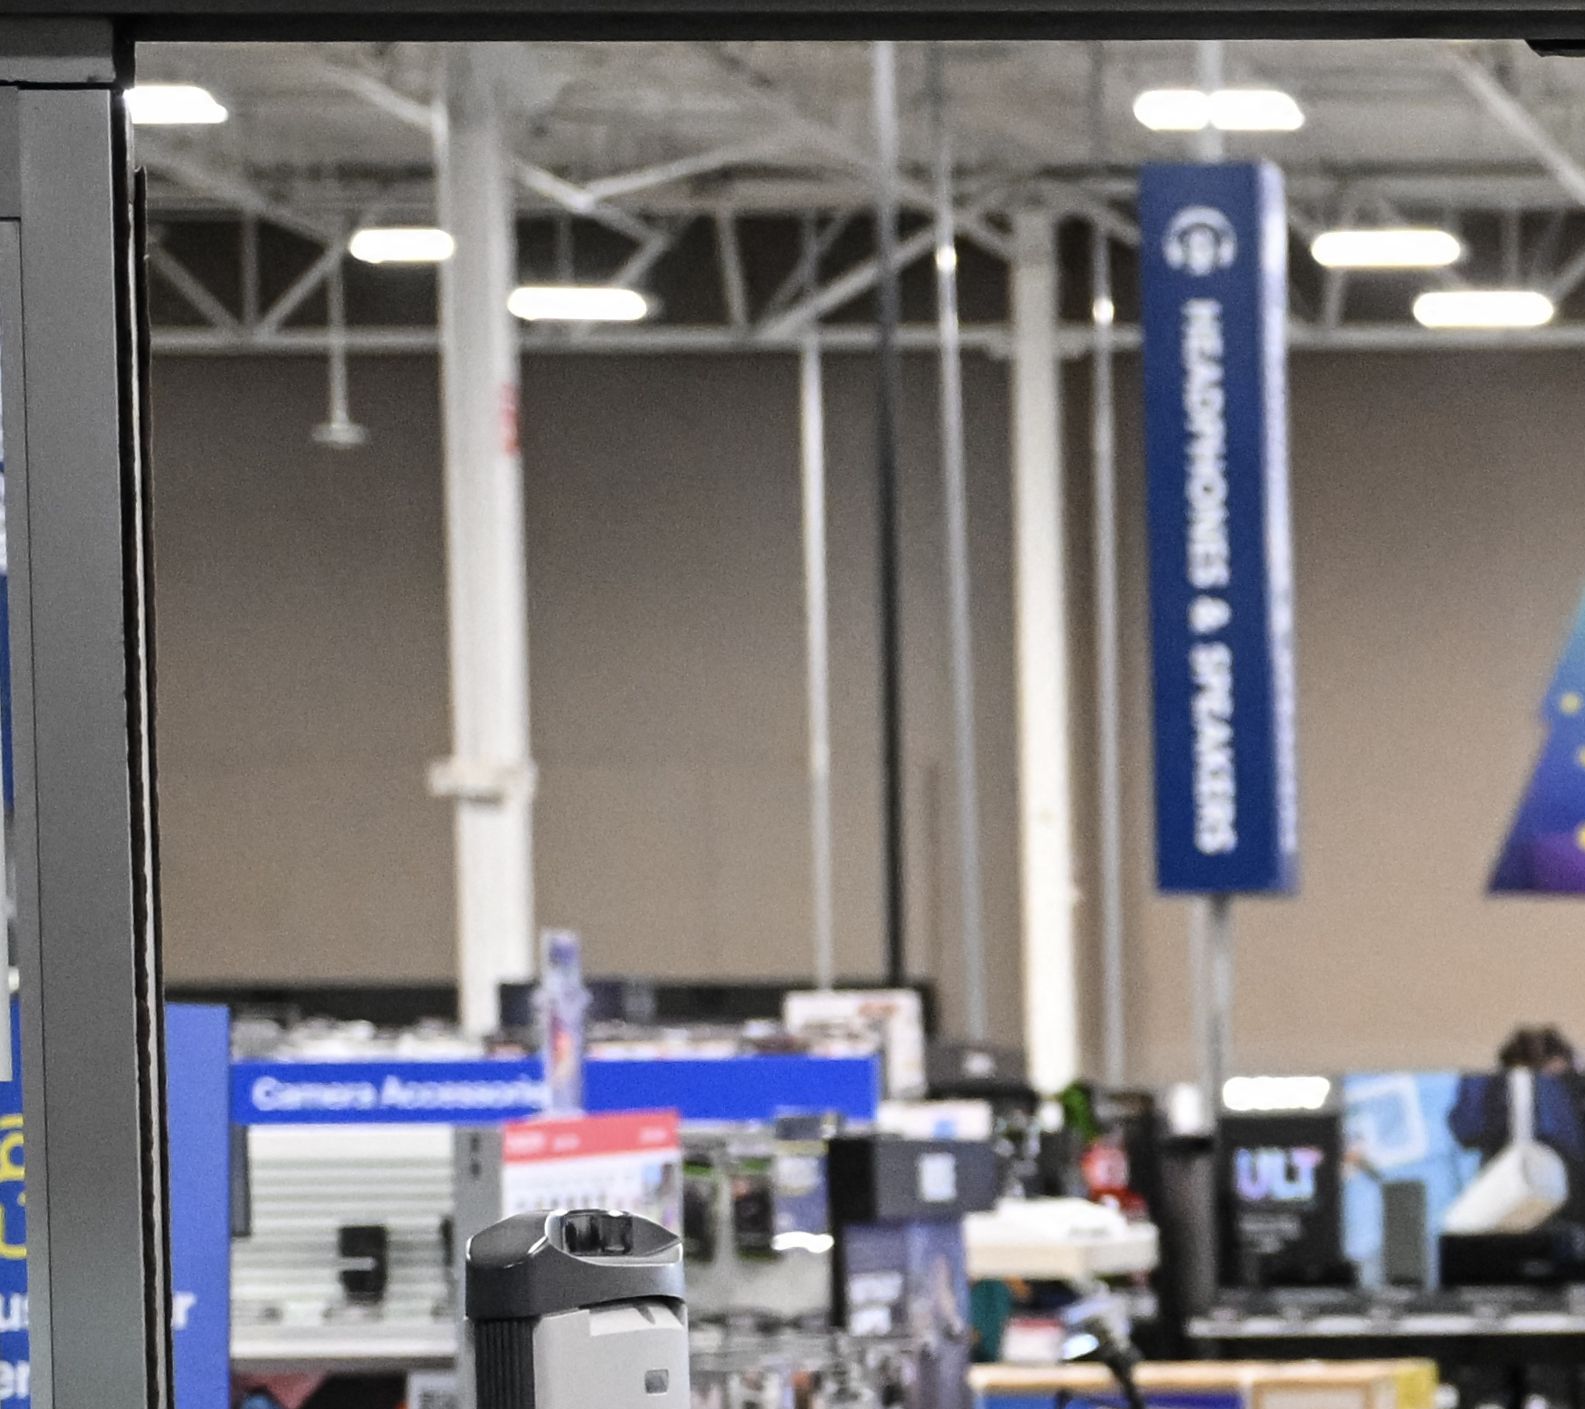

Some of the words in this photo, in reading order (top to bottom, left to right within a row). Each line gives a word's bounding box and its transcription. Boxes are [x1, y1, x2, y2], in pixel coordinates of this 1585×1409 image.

[1182, 298, 1231, 589] HEADPHONES
[1188, 594, 1233, 635] &
[1188, 641, 1238, 855] SPEAKERS
[252, 1075, 378, 1112] Camera
